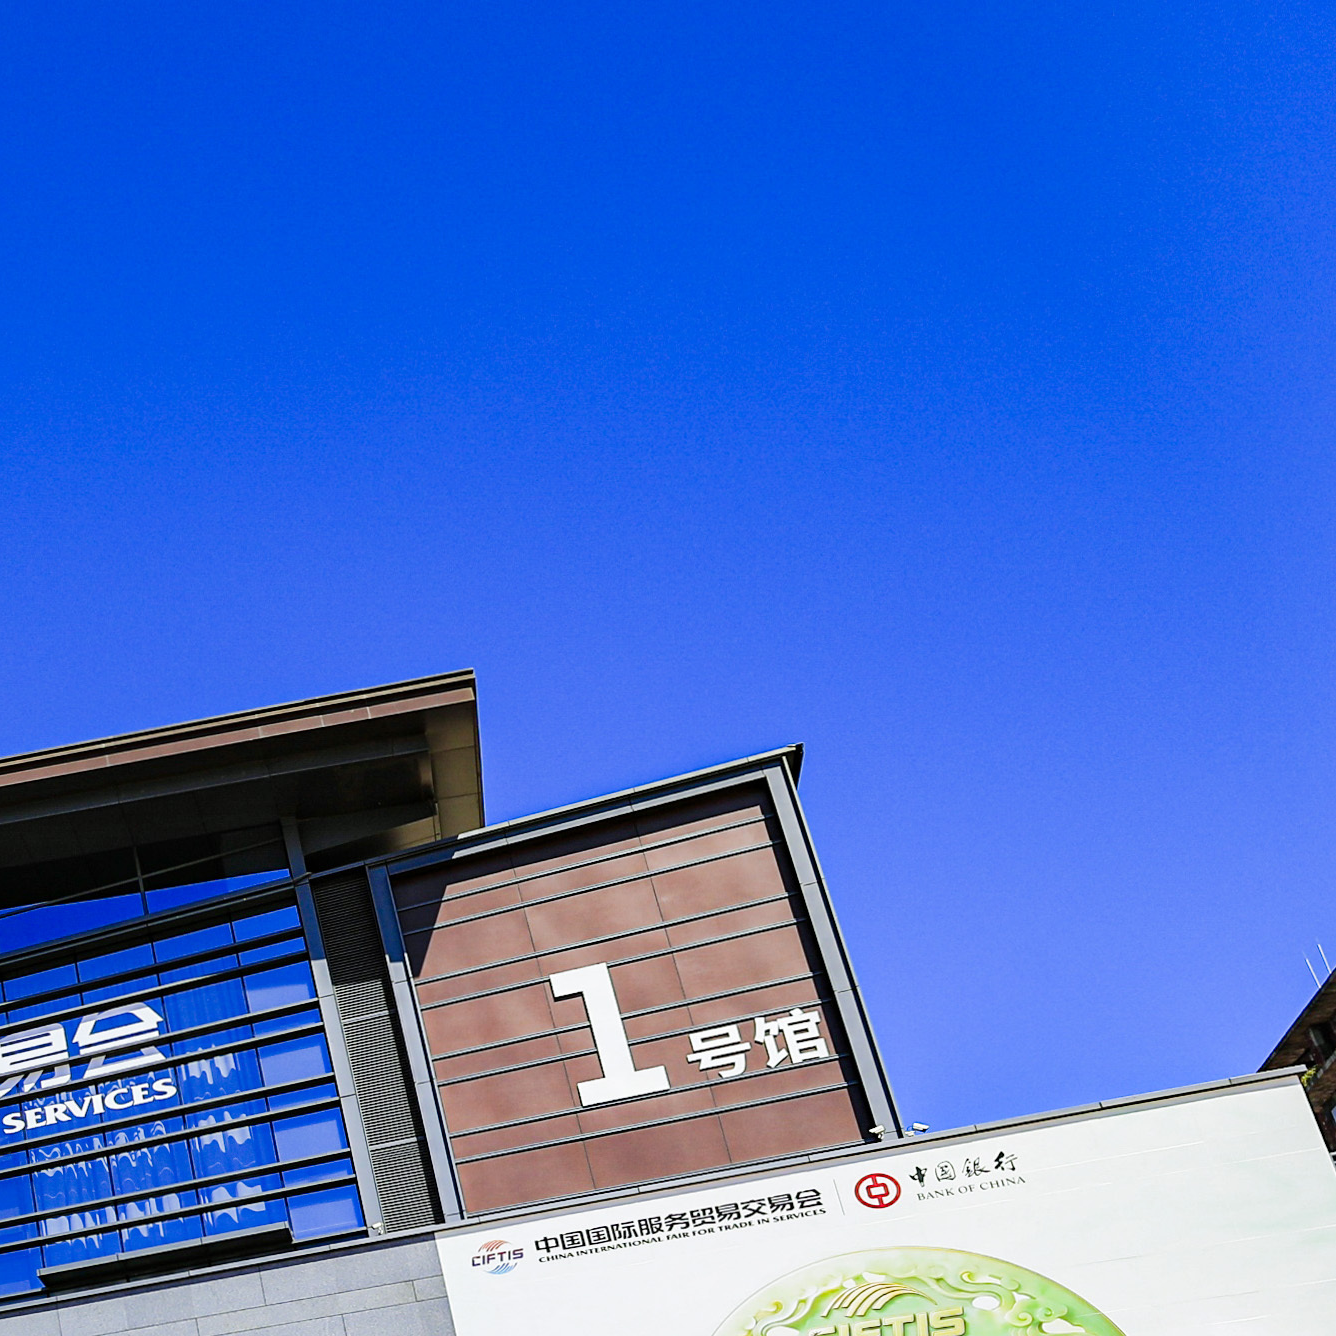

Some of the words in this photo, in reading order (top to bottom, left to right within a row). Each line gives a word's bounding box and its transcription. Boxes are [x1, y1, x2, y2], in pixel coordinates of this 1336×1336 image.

[3, 1077, 179, 1136] SERVICES
[917, 1187, 955, 1201] BANK
[958, 1183, 975, 1194] OF
[979, 1175, 1026, 1191] CHINA
[534, 1188, 824, 1254] 中国国际服务贸易交易会
[538, 1252, 575, 1264] CHINA
[576, 1236, 664, 1257] INTERNATIONAL
[666, 1230, 690, 1242] FAIR
[692, 1226, 716, 1237] FOR
[717, 1220, 755, 1233] TRADE
[756, 1218, 770, 1227] IN
[772, 1207, 827, 1223] SERVICES
[471, 1247, 524, 1267] CIFTIS
